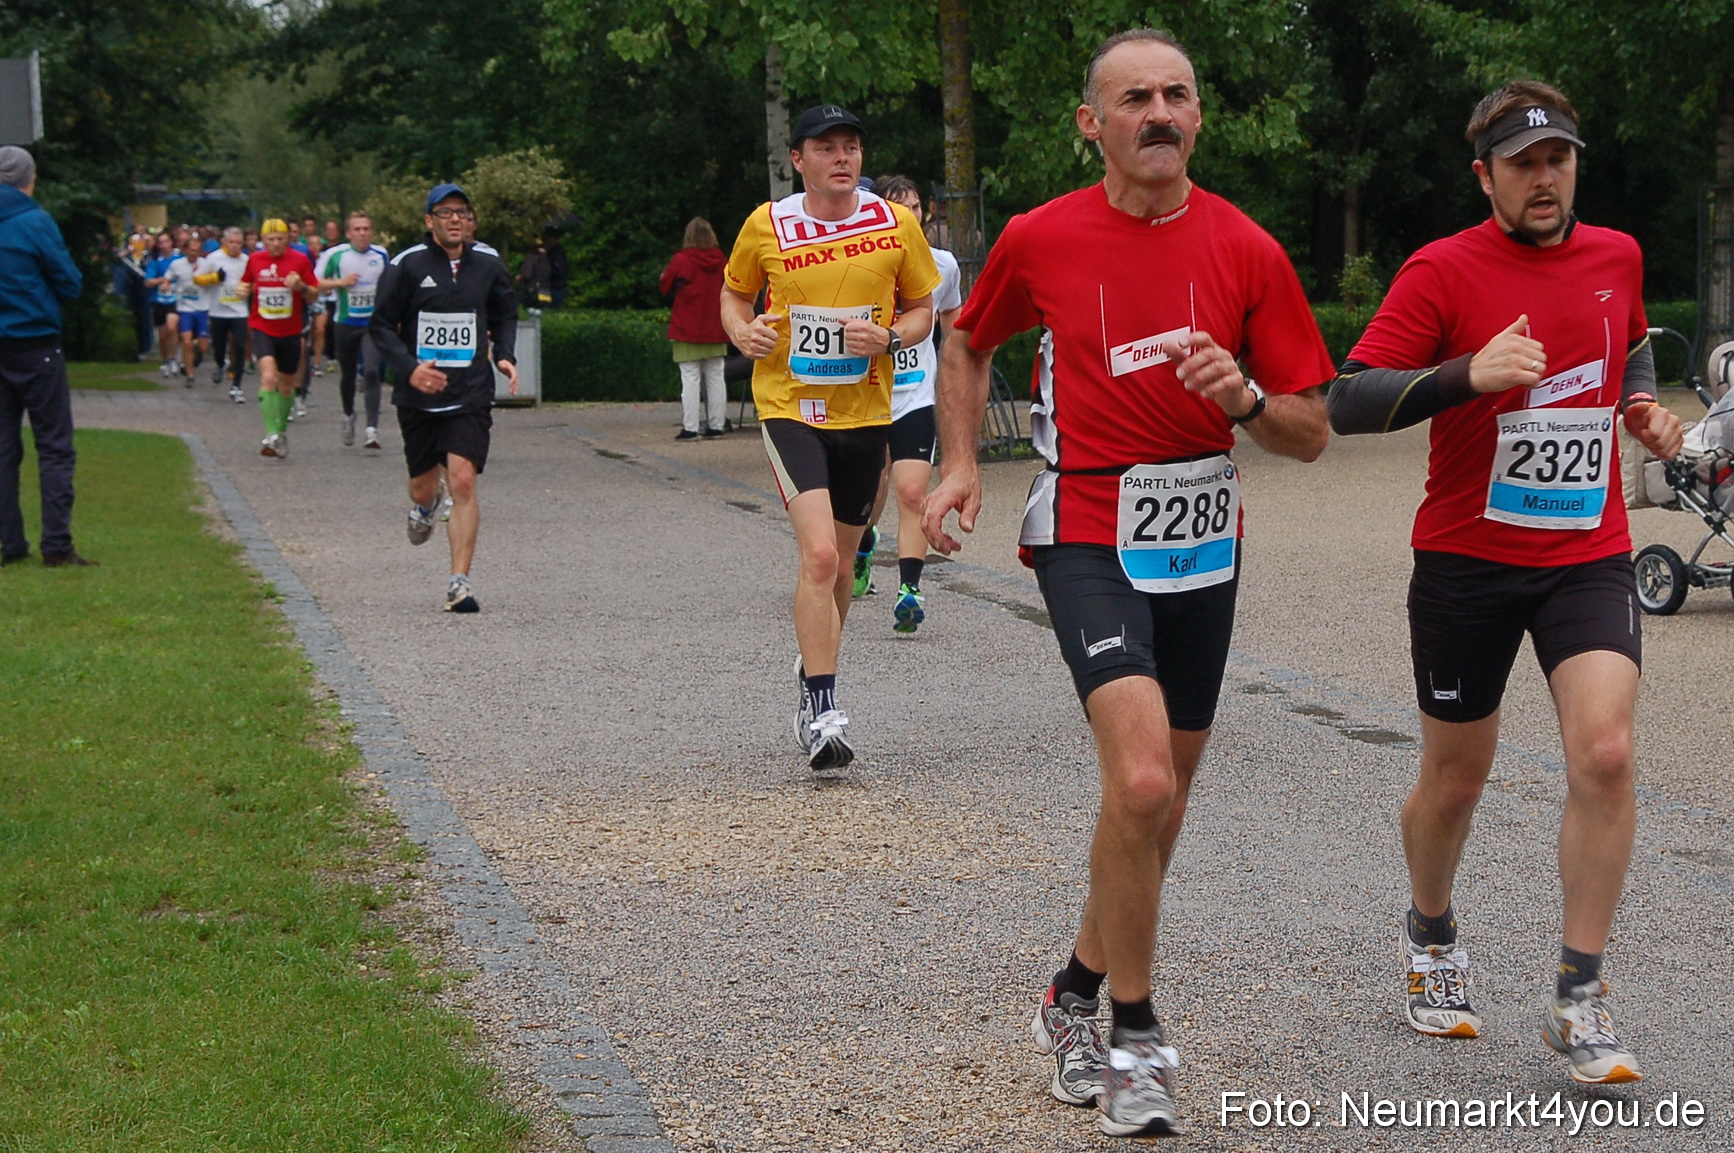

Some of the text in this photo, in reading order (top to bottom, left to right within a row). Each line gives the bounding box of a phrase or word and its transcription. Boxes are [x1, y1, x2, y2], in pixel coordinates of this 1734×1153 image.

[782, 235, 902, 273] MAX BÖGL
[791, 312, 817, 322] PARTL
[424, 326, 471, 346] 2849
[798, 324, 845, 355] 291
[807, 361, 852, 374] Andreas
[1550, 373, 1583, 394] DEHN
[1501, 421, 1599, 435] PARTL Neumarkt
[1506, 438, 1603, 483] 2329
[1123, 471, 1222, 490] PARTL Neumarkt
[1522, 494, 1585, 511] Manuel
[1132, 487, 1231, 542] 2288
[1168, 552, 1198, 573] Karl
